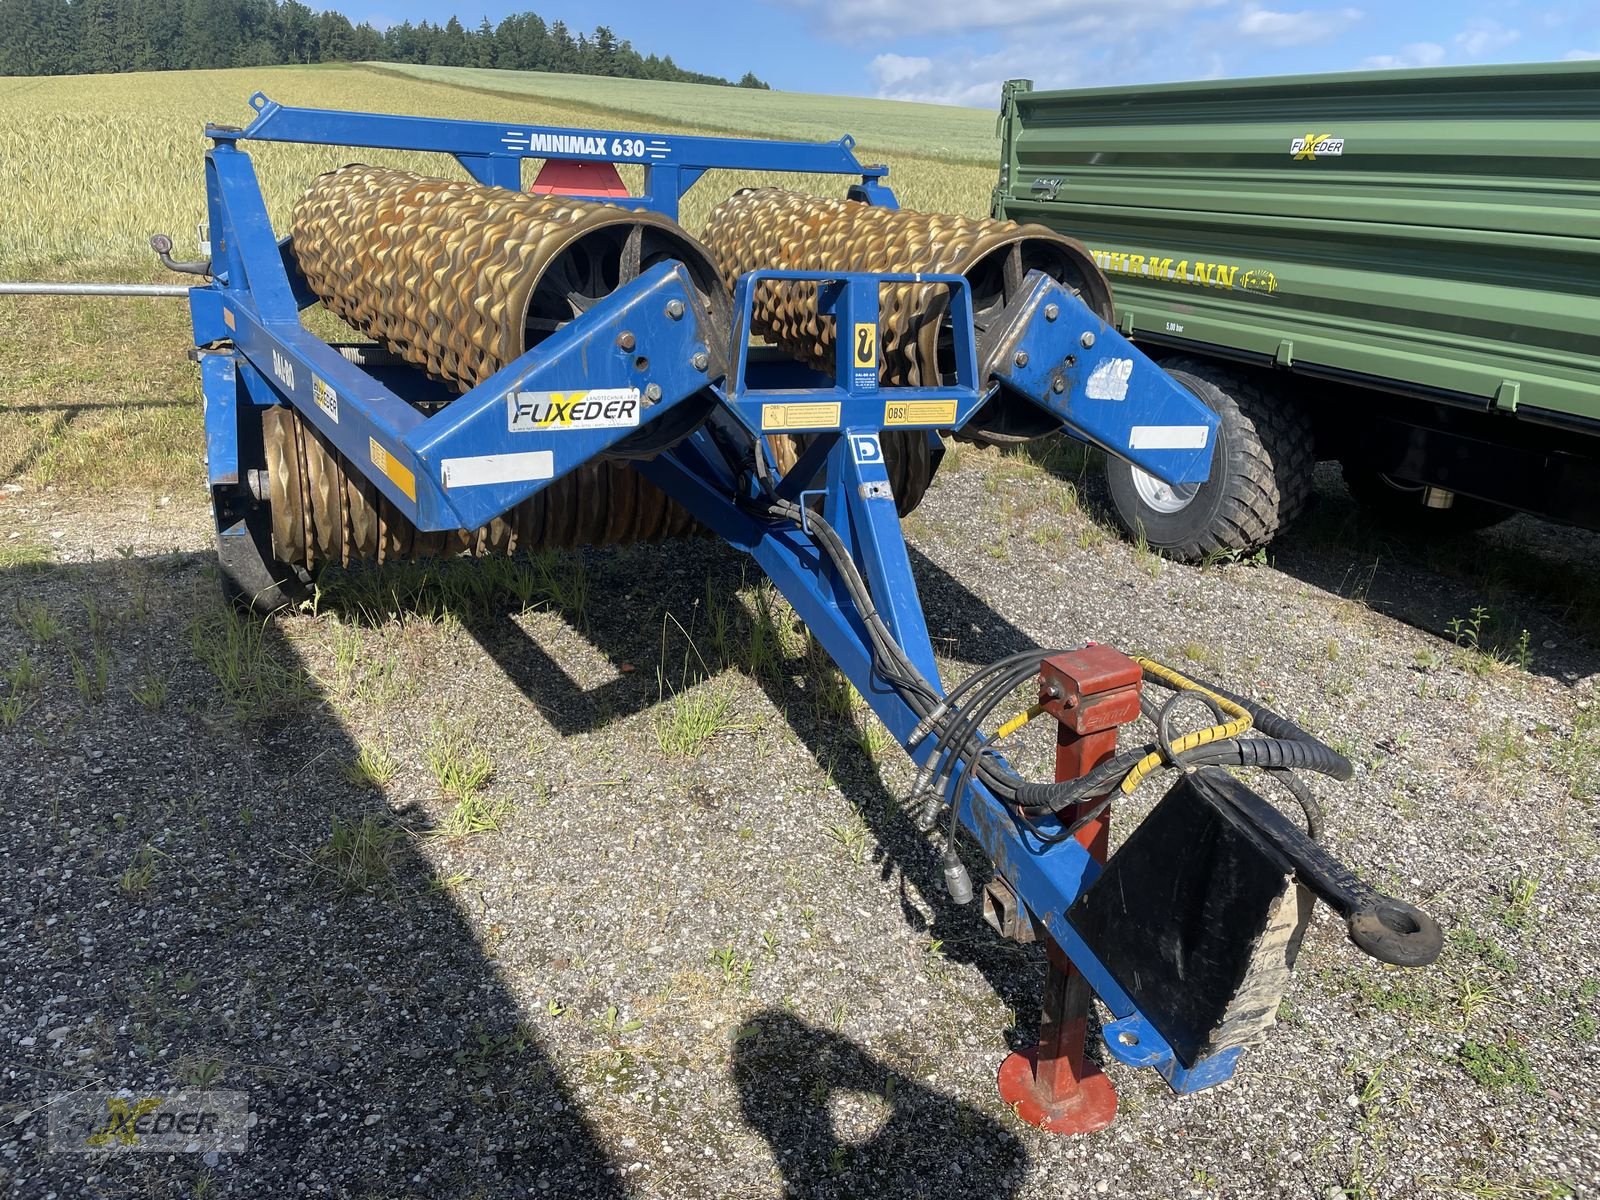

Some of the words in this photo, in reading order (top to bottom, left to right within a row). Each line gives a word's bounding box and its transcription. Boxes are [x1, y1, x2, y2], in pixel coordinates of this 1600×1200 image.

[530, 133, 607, 155] MINIMAX
[611, 138, 645, 158] 630
[1093, 250, 1239, 291] UHRMANN
[512, 399, 637, 424] FLIXEDER
[888, 407, 907, 420] OBS!
